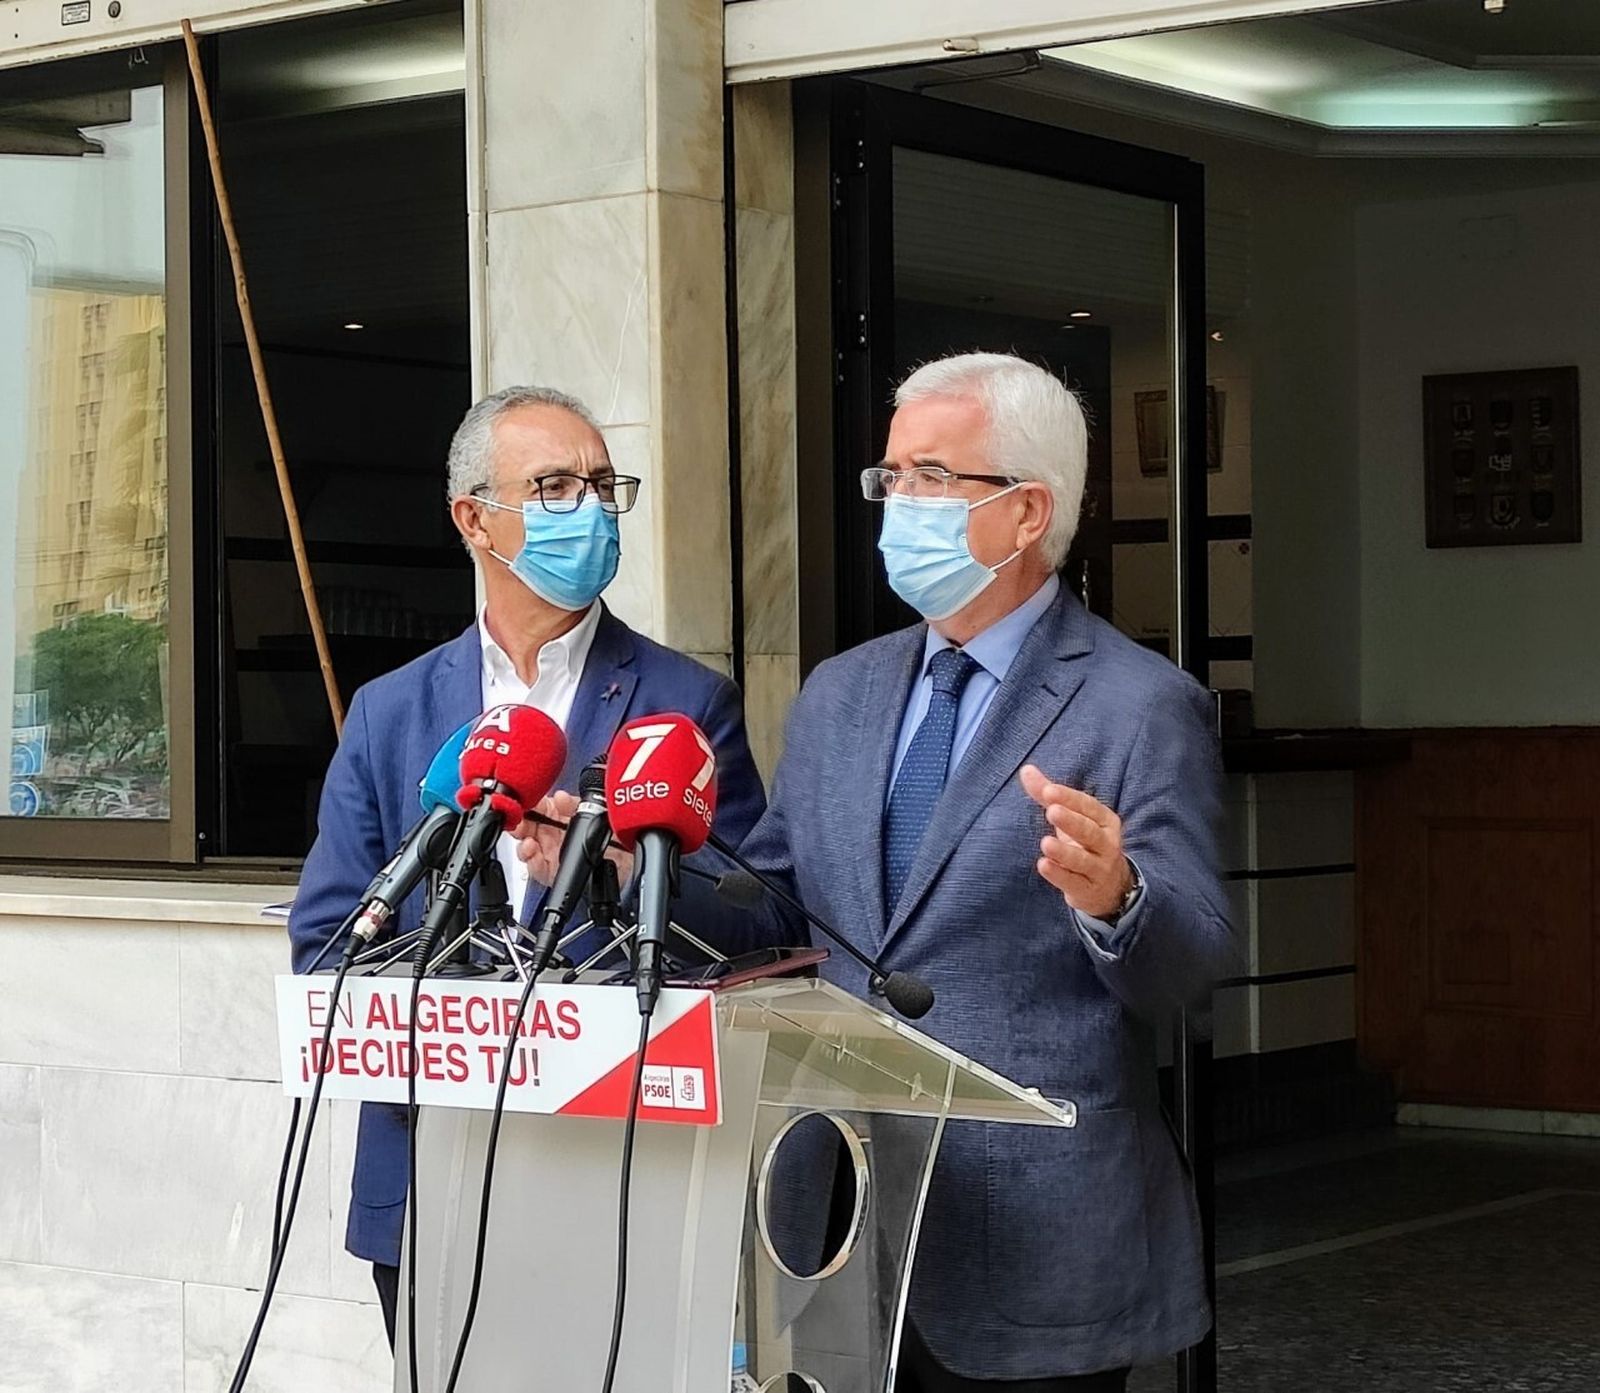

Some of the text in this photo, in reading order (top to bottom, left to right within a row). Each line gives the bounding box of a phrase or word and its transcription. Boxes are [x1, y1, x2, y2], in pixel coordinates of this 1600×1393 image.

[620, 723, 677, 783] 7
[307, 990, 581, 1040] EN ALGECIRAS
[301, 1037, 469, 1083] ¡DECIDES
[644, 1084, 671, 1099] PSOE
